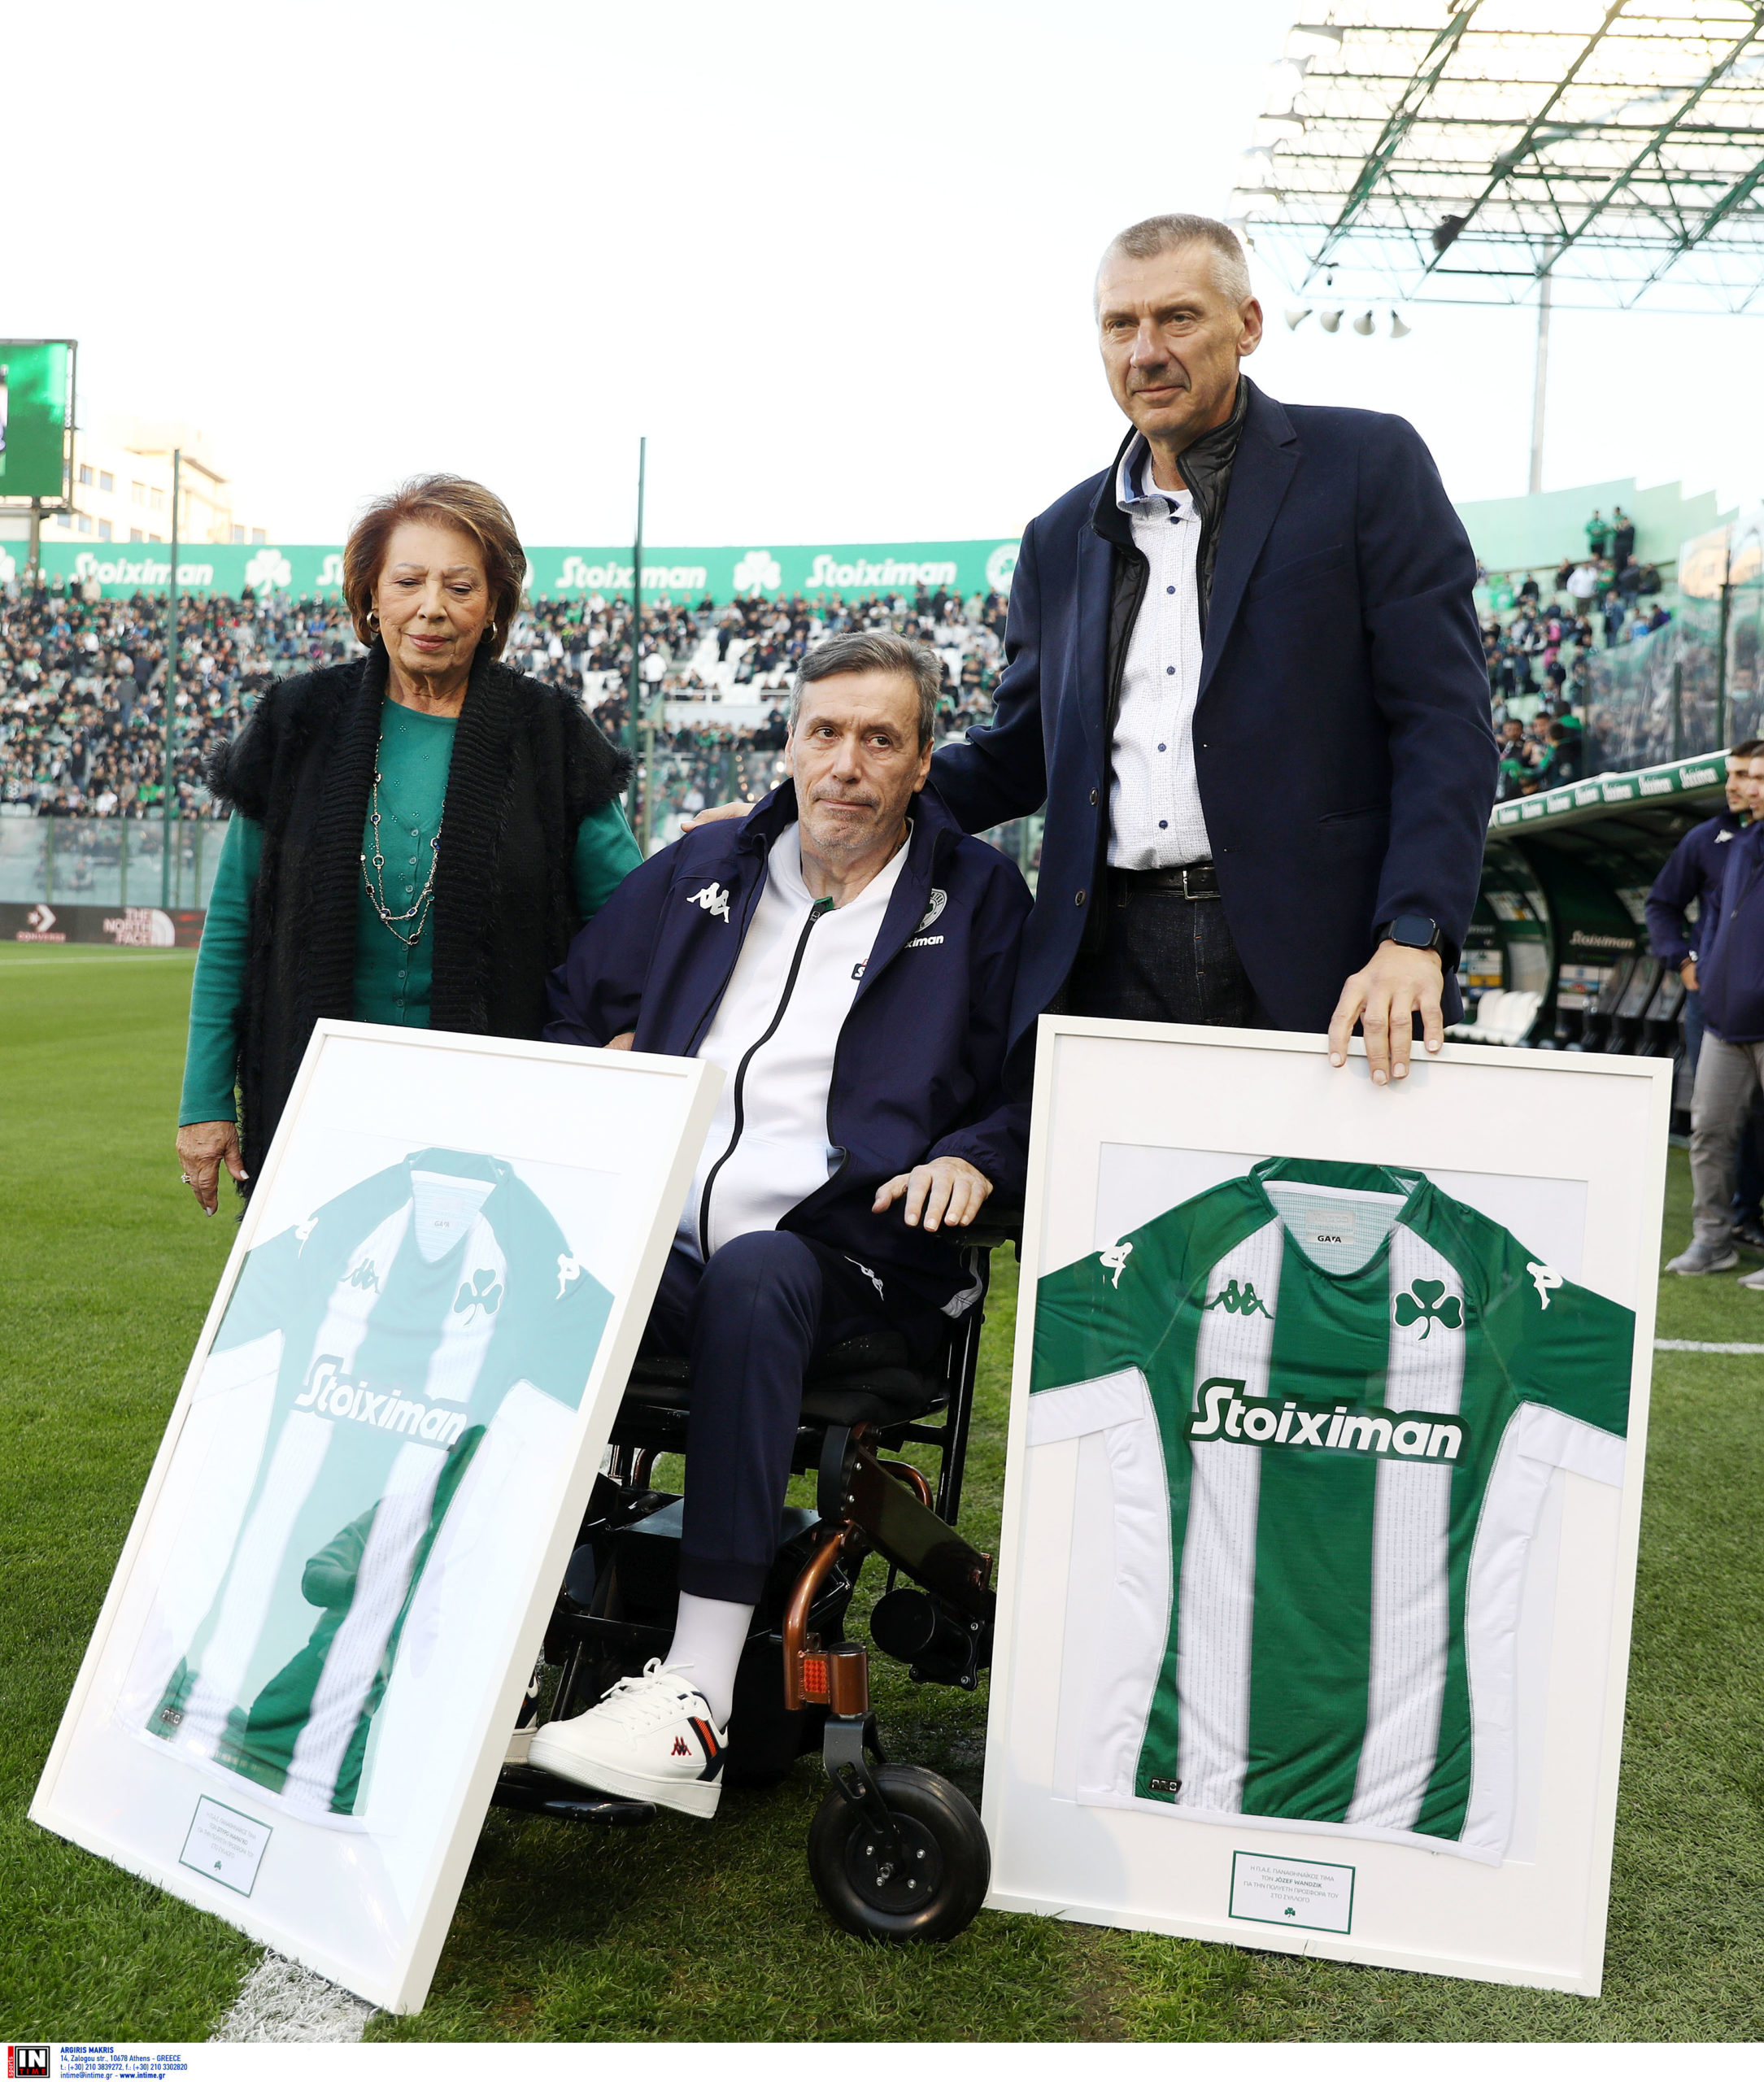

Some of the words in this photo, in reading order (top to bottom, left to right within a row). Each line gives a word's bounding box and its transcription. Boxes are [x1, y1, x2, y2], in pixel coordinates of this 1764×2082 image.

[68, 552, 214, 586] Stoiximan
[555, 555, 707, 589] Stoixman
[805, 554, 957, 588] Stoiximan
[103, 918, 152, 933] NORTH
[125, 908, 151, 920] THE
[115, 933, 151, 945] FACE
[904, 935, 944, 948] ximan
[294, 1361, 468, 1444] Stoiximan
[1190, 1385, 1462, 1458] Stoiximan
[1294, 1879, 1322, 1888] WANDZIK
